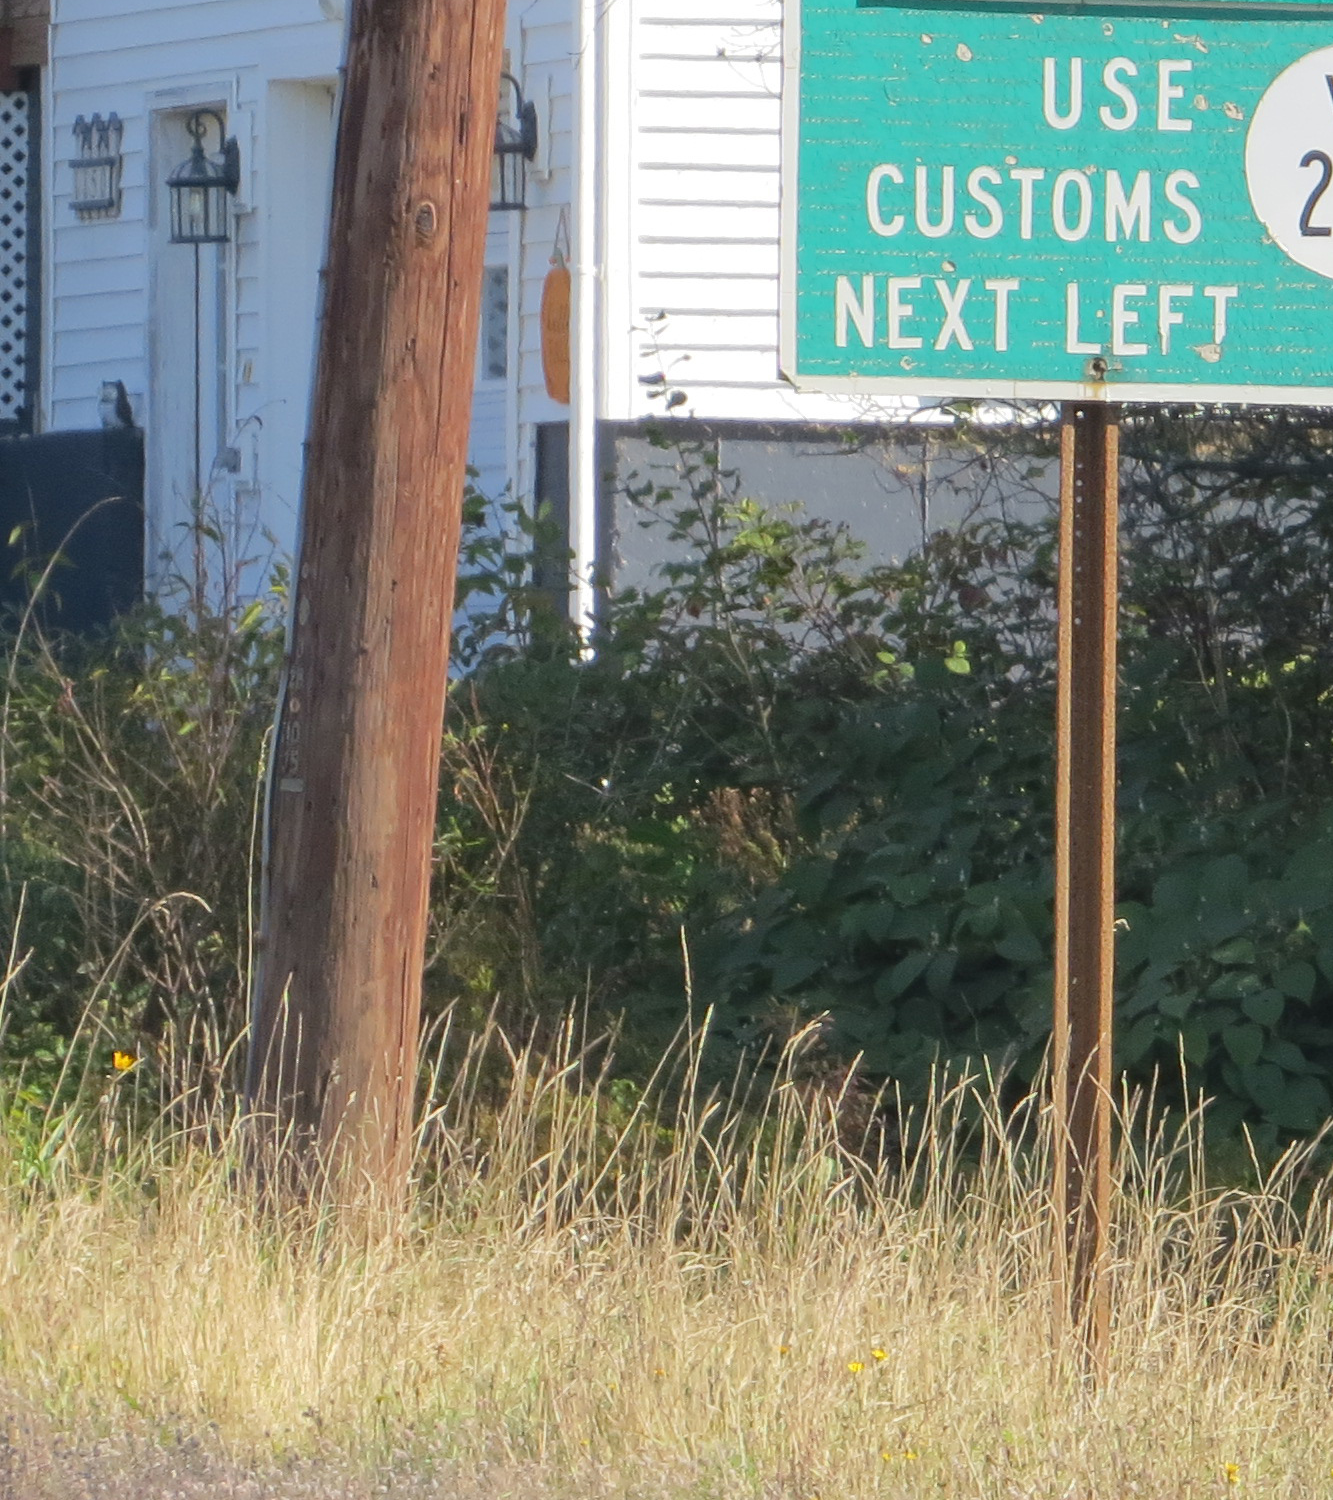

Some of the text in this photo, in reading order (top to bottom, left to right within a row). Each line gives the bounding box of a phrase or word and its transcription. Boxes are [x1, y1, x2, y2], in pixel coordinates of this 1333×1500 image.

[1043, 56, 1194, 132] USE
[866, 163, 1203, 245] CUSTOMS
[835, 275, 1239, 357] NEXT LEFT
